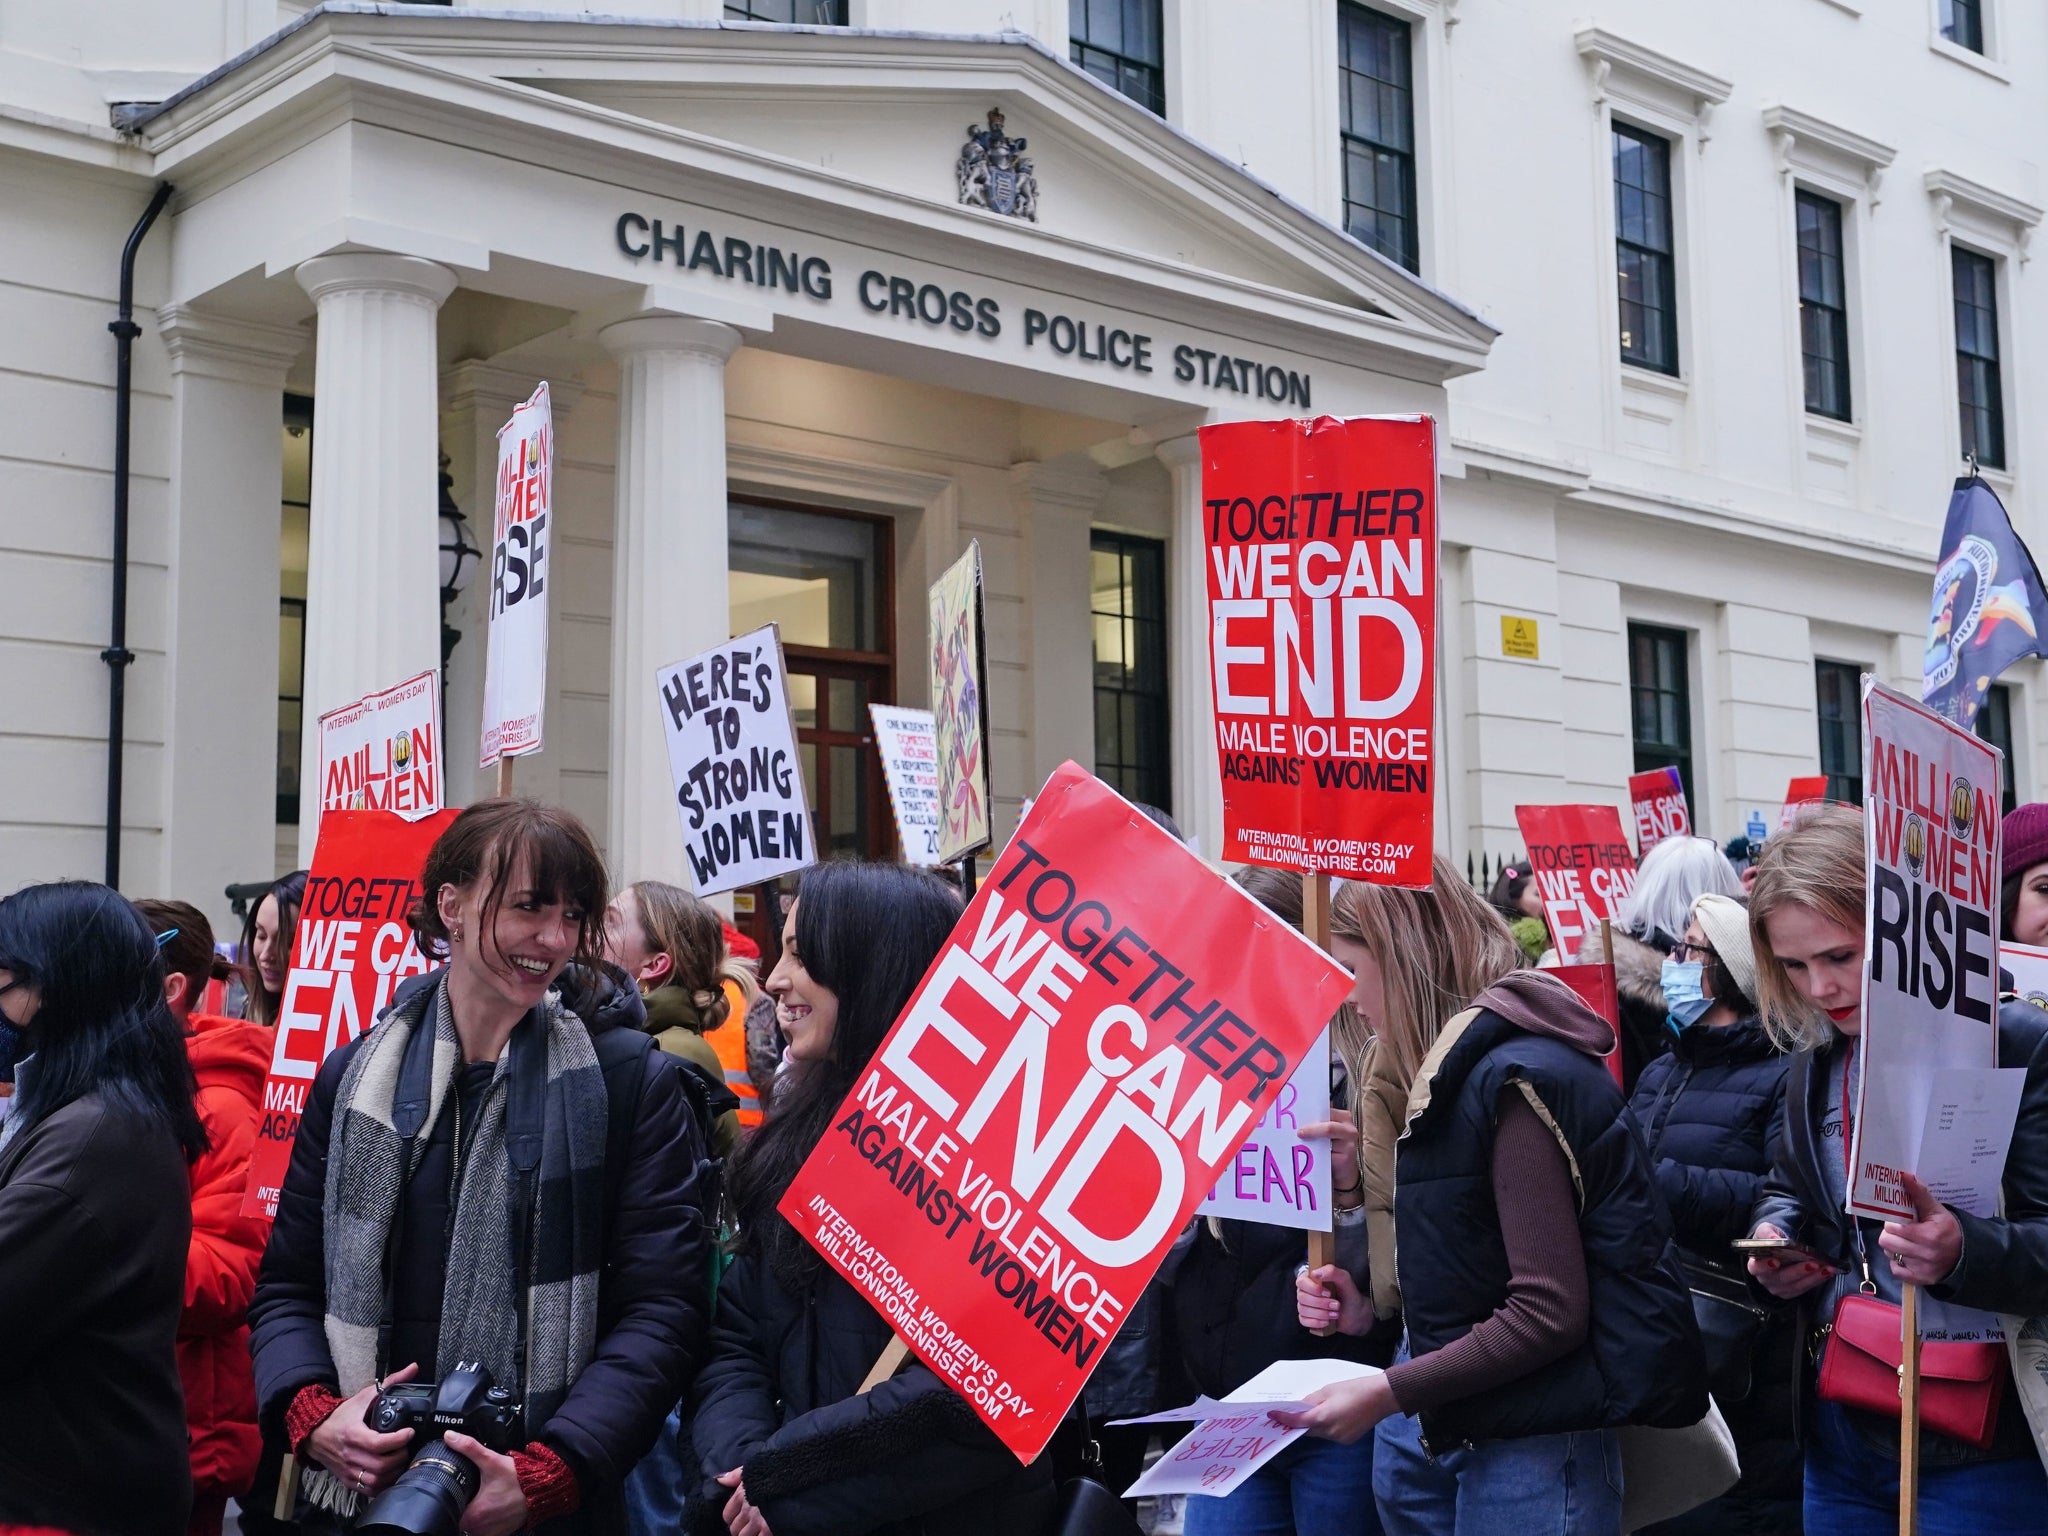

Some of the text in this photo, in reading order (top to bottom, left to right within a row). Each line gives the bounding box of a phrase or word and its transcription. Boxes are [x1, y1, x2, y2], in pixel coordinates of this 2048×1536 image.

[616, 212, 1312, 409] CHARING CROSS POLICE STATION
[1206, 488, 1425, 543] TOGETHER
[1211, 538, 1423, 600] WE CAN
[662, 646, 772, 732] HERE'S
[1212, 597, 1424, 720] END
[704, 706, 741, 756] TO
[1218, 720, 1287, 754] MALE
[678, 746, 793, 830] STRONG
[1313, 760, 1427, 793] WOMEN
[1633, 799, 1653, 816] WE
[1871, 735, 1996, 853] MILLION
[685, 809, 803, 887] WOMEN
[1312, 837, 1381, 857] WOMEN'S
[1383, 843, 1415, 860] DAY
[1529, 844, 1634, 869] TOGETHER
[1636, 809, 1687, 842] END
[1874, 800, 1993, 912] WOMEN
[1537, 869, 1586, 901] WE
[300, 919, 362, 972] WE
[998, 839, 1287, 1103] TOGETHER
[1871, 863, 1992, 1025] RISE
[969, 888, 1253, 1168] WE CAN
[879, 943, 1187, 1268] END
[856, 1069, 1124, 1338] MALE VIOLENCE
[1207, 1143, 1318, 1211] EAR
[835, 1109, 1100, 1370] AGAINST WOMEN
[808, 1193, 1035, 1419] INTERNATIONAL WOMEN'S DAY
[814, 1224, 1004, 1421] MILLIONWOMENRISE.COM
[433, 1414, 464, 1425] Nikon
[1174, 1436, 1276, 1462] NEVER
